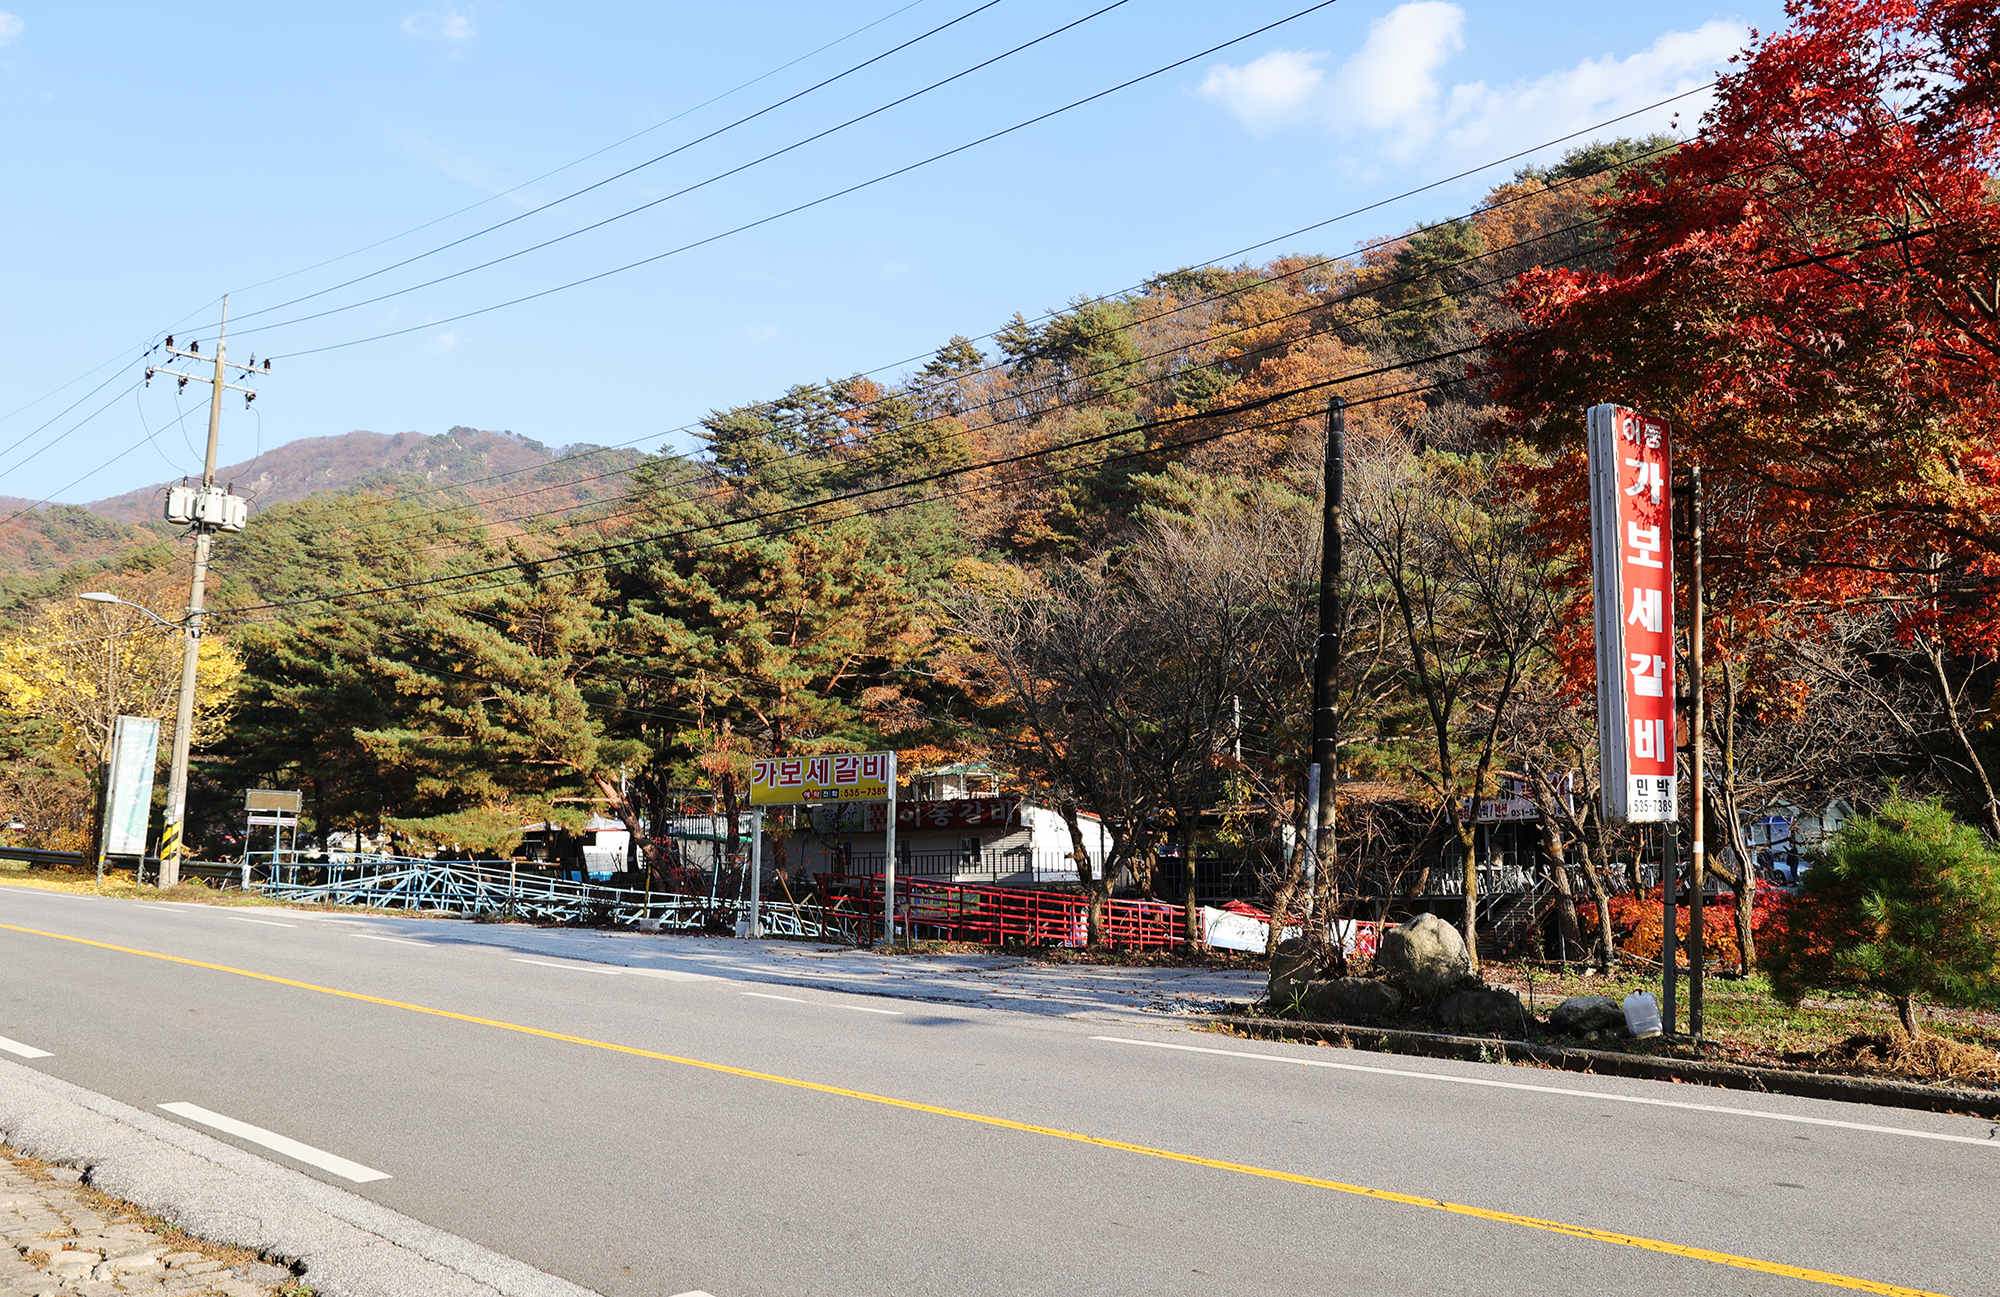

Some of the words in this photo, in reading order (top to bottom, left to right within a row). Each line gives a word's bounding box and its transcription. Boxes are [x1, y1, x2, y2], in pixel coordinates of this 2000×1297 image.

[1622, 417, 1662, 449] 이동
[1624, 457, 1667, 763] 가보세갈비
[752, 754, 888, 789] 가보세갈비
[1636, 778, 1670, 797] 민박
[899, 799, 1016, 828] 이동갈비
[1633, 799, 1673, 813] 535-7389
